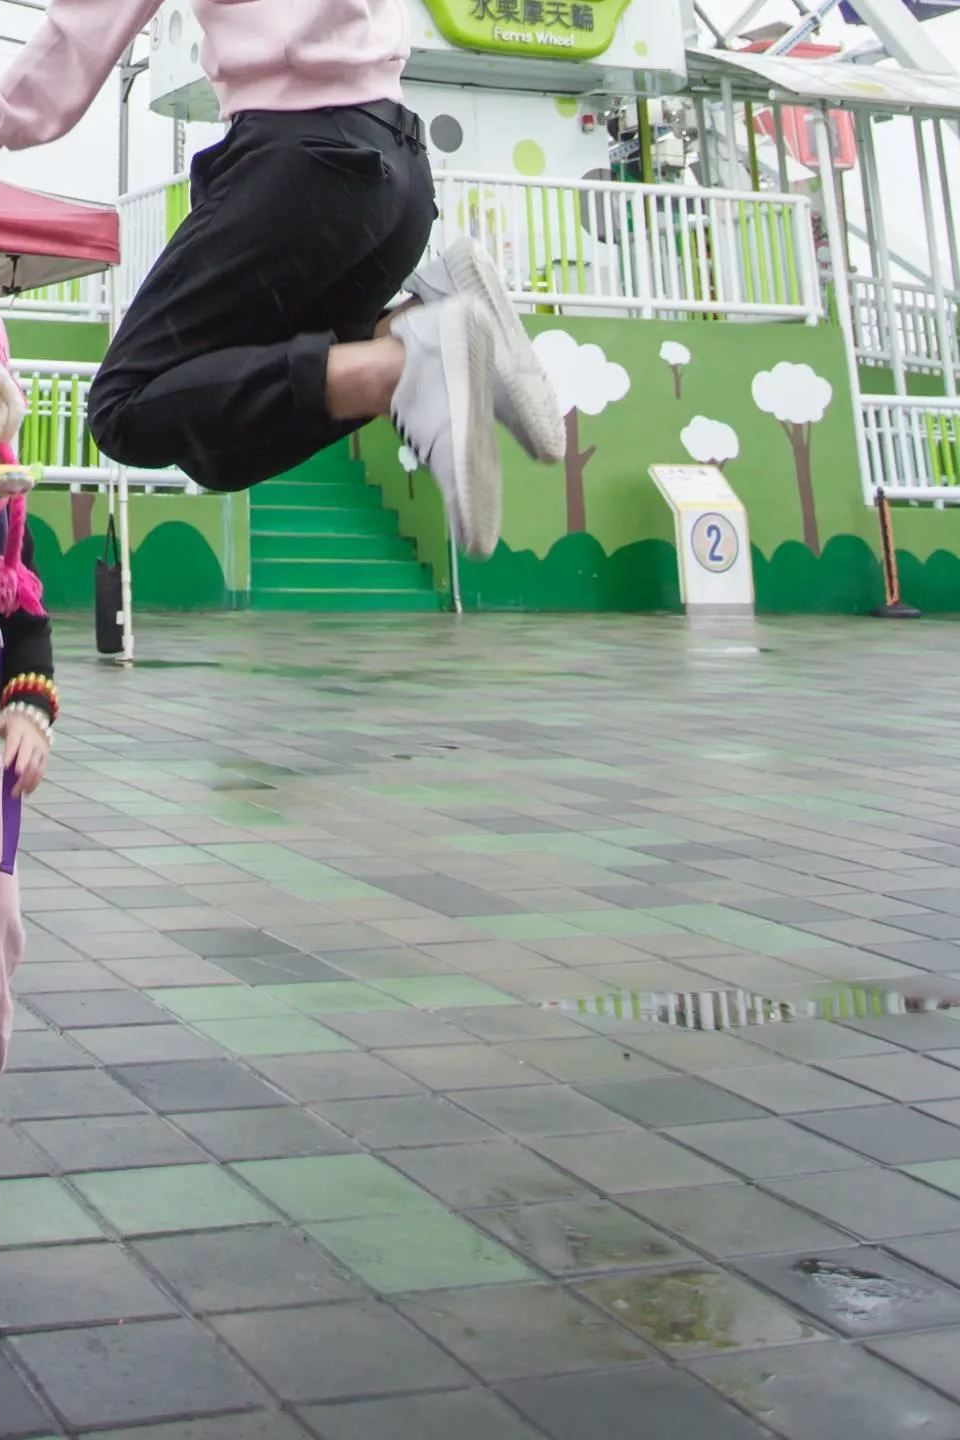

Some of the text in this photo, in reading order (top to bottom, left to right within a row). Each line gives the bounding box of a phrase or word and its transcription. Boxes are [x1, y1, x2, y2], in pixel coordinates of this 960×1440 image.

[494, 27, 575, 48] Ferris Wheel
[706, 524, 724, 561] 2
